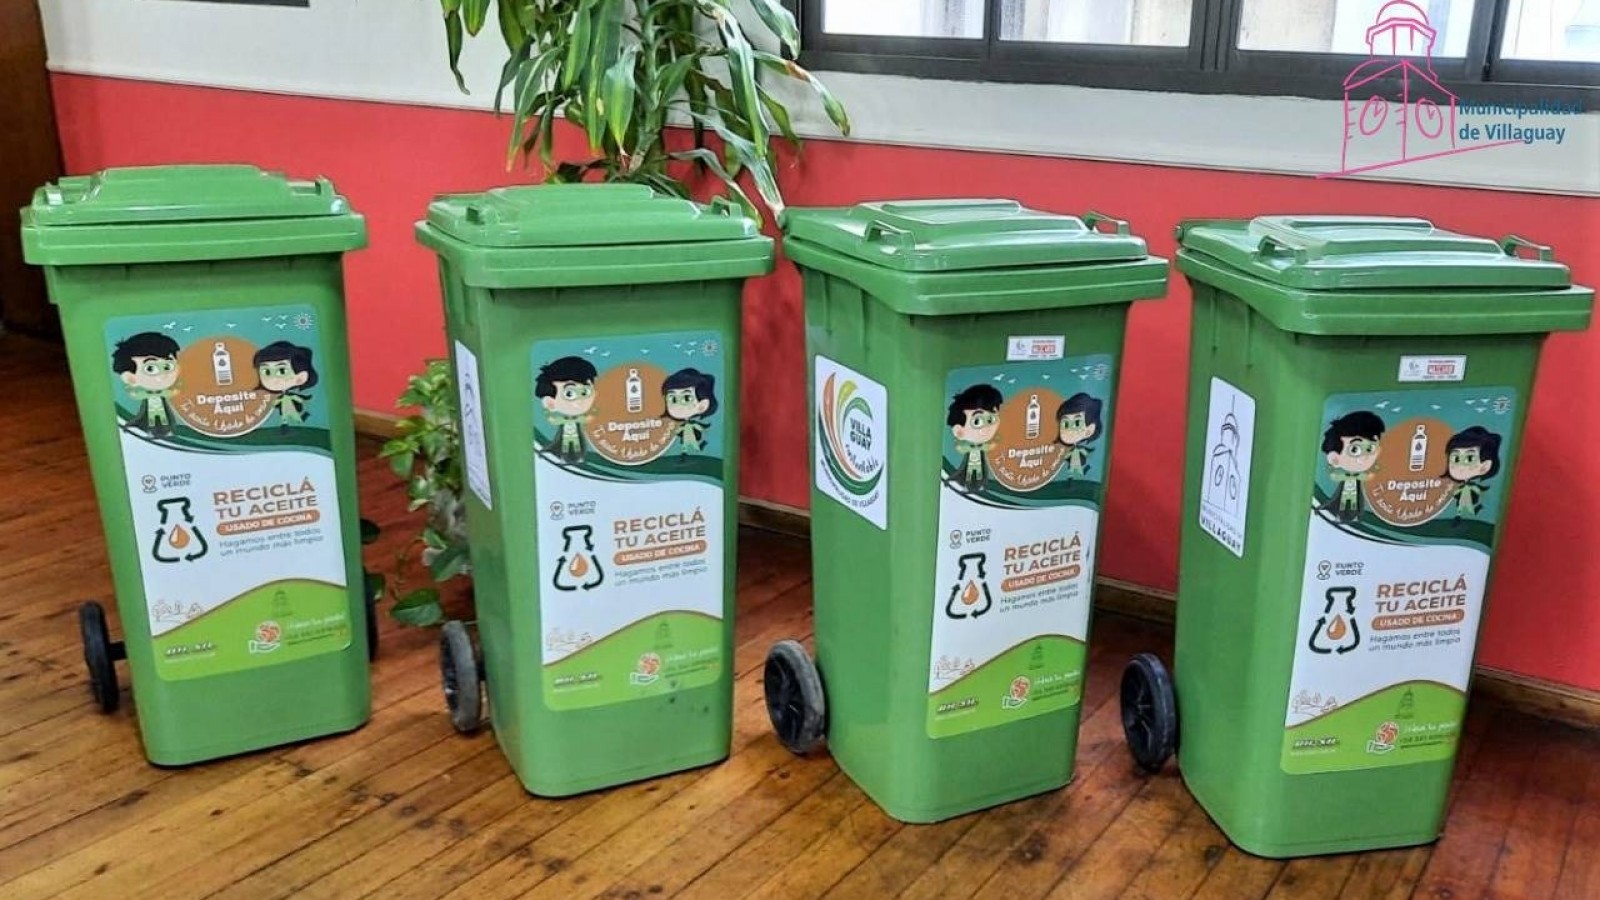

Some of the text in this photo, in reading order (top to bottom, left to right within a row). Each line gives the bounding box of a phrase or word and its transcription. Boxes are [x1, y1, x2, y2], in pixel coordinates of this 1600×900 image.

[196, 391, 257, 405] Deposite
[608, 419, 662, 431] Deposite
[850, 417, 871, 437] VILLA
[850, 430, 872, 451] GUAY
[1008, 445, 1055, 458] Deposite
[160, 473, 191, 481] PUNTO
[161, 480, 191, 488] VERDE
[213, 476, 315, 505] RECICLÁ
[1387, 479, 1441, 491] Deposite
[214, 495, 319, 520] TU ACEITE
[568, 501, 597, 509] PUNTO
[568, 508, 596, 516] VERDE
[225, 513, 313, 532] USADO DE COCINA
[613, 506, 705, 535] RECICLÁ
[614, 526, 706, 549] TU ACEITE
[965, 528, 992, 536] PUNTO
[966, 535, 991, 543] VERDE
[1201, 515, 1242, 551] VILLAGUAY
[219, 537, 266, 548] Hagamos
[1003, 531, 1081, 561] RECICLÁ
[622, 543, 701, 561] USADO DE COCINA
[1003, 550, 1081, 576] TU ACEITE
[1335, 561, 1365, 569] PUNTO
[614, 568, 656, 577] Hagamos
[1008, 568, 1076, 588] USADO DE COCINA
[1335, 568, 1363, 576] VERDE
[1377, 573, 1467, 598] RECICLÁ
[1000, 593, 1036, 604] Hagamos
[1375, 594, 1467, 613] TU ACEITE
[1380, 612, 1457, 627] USADO DE COCINA
[1370, 634, 1411, 644] Hagamos
